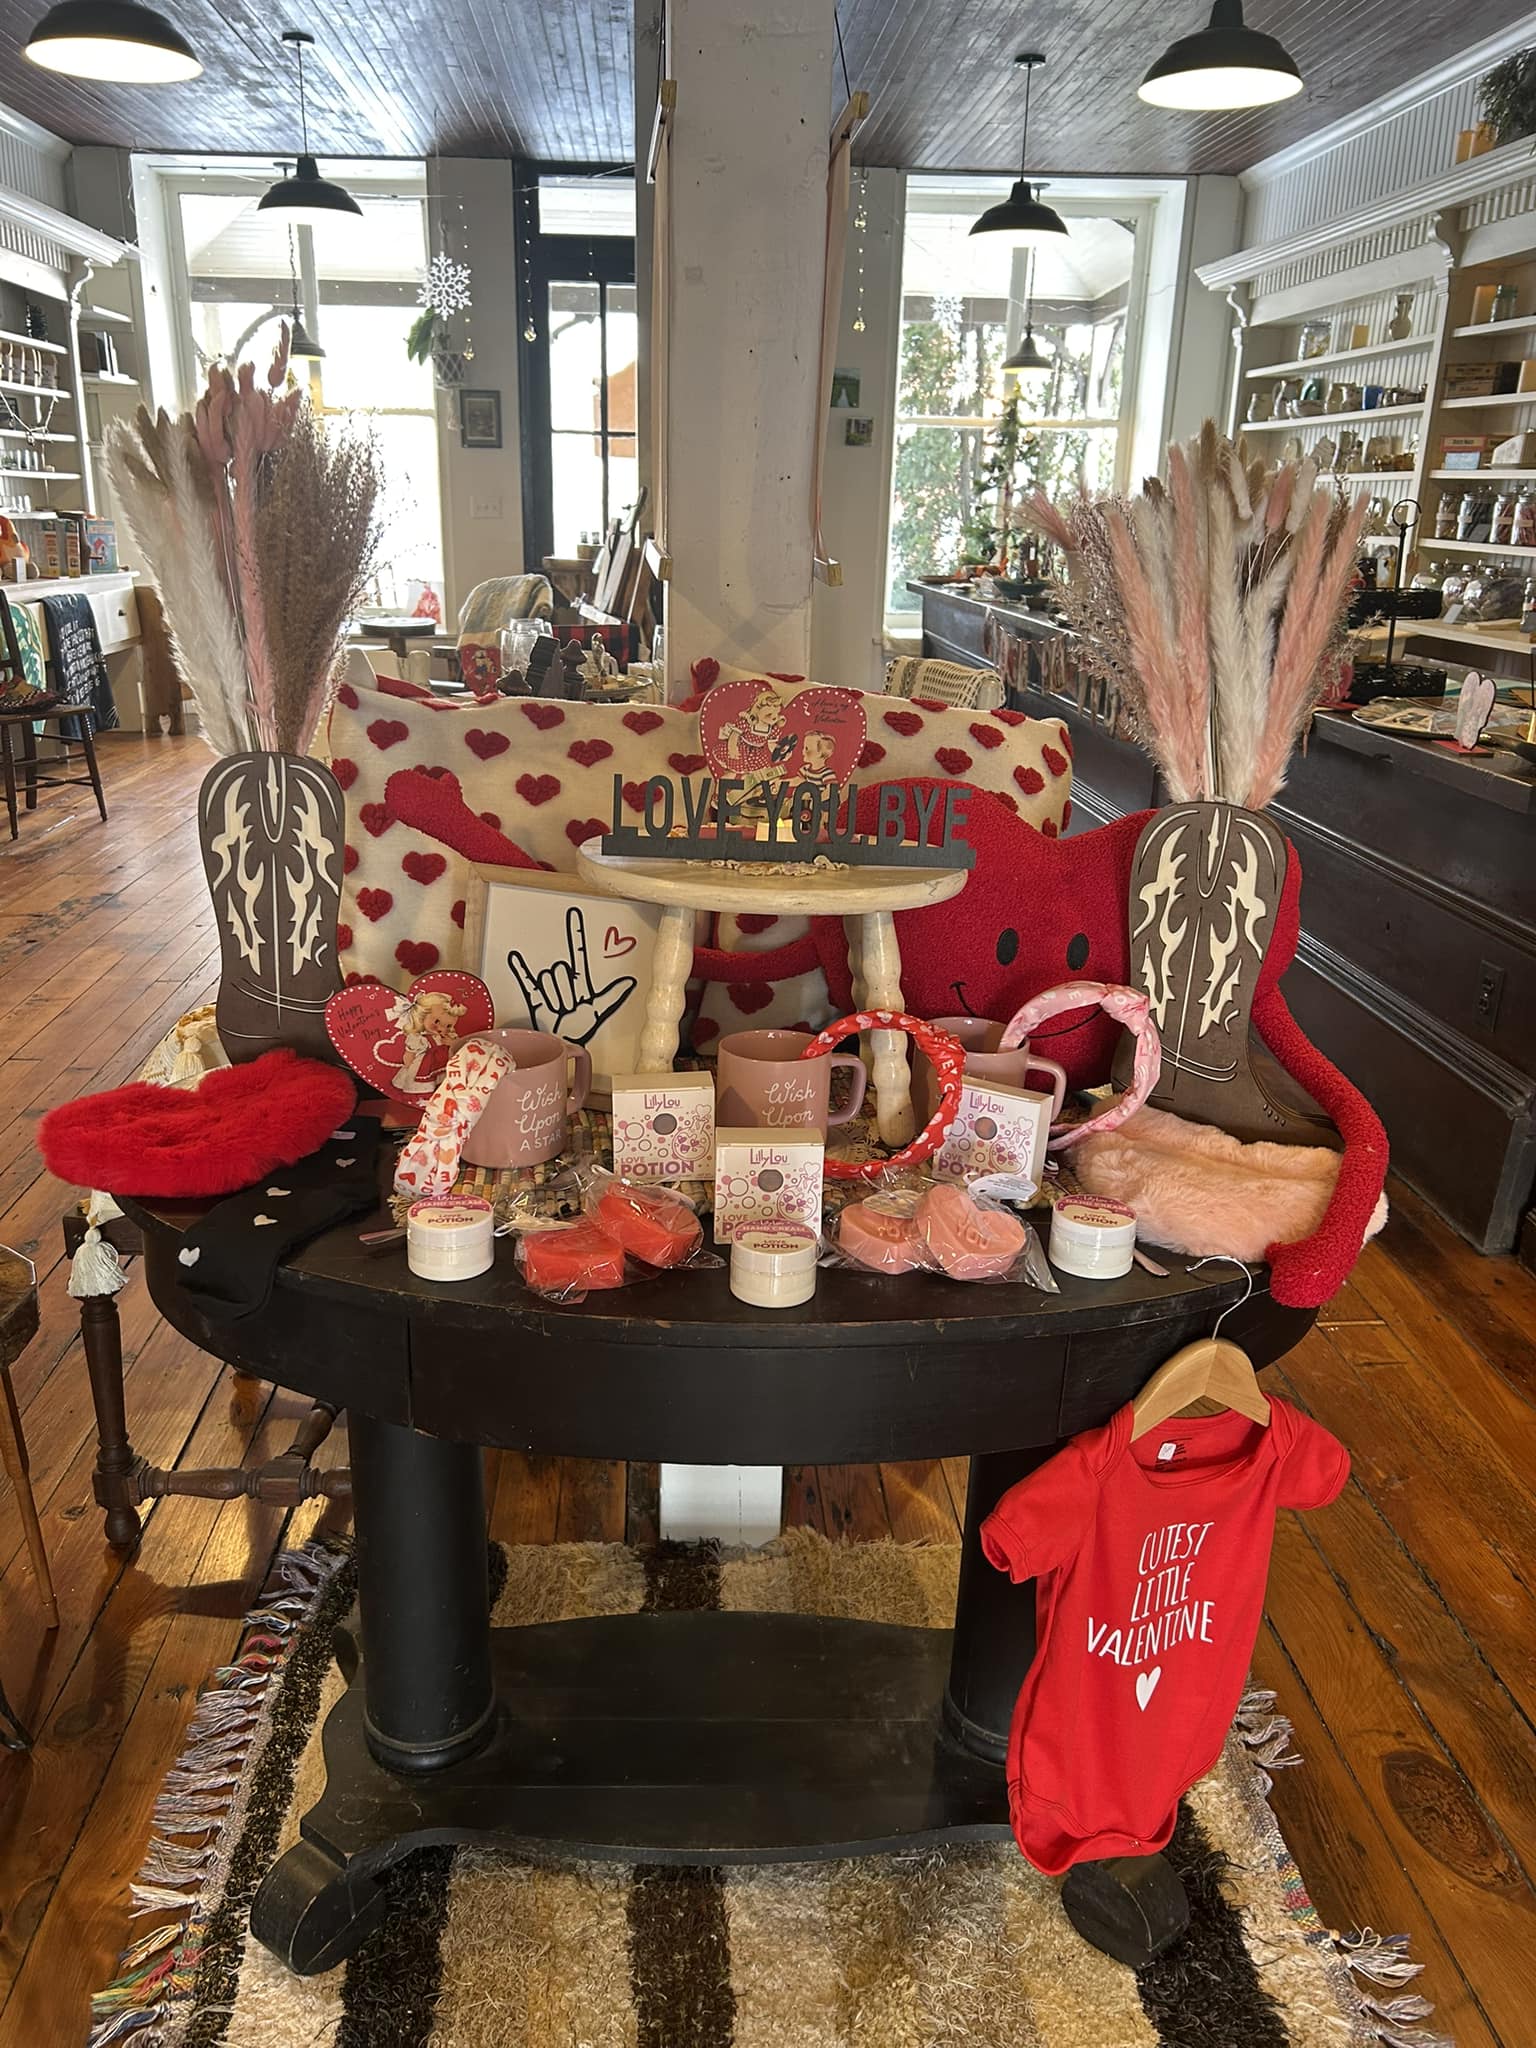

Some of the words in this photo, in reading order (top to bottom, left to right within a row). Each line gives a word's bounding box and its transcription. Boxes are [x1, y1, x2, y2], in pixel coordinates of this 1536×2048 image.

[614, 773, 745, 845] LOVE
[879, 784, 972, 851] BYE
[515, 1080, 562, 1112] Wish
[763, 1077, 817, 1104] Wish
[514, 1112, 561, 1138] Upon
[761, 1106, 815, 1129] Upon
[519, 1137, 532, 1152] A
[534, 1128, 562, 1149] STAR
[620, 1156, 646, 1164] LOVE
[620, 1160, 695, 1177] POTION
[940, 1151, 964, 1161] LOVE
[428, 1216, 473, 1224] POTION
[1073, 1215, 1118, 1225] POTION
[1138, 1521, 1216, 1576] CUTEST
[1130, 1561, 1196, 1623] LITTLE
[1086, 1600, 1216, 1666] VALENTINE
